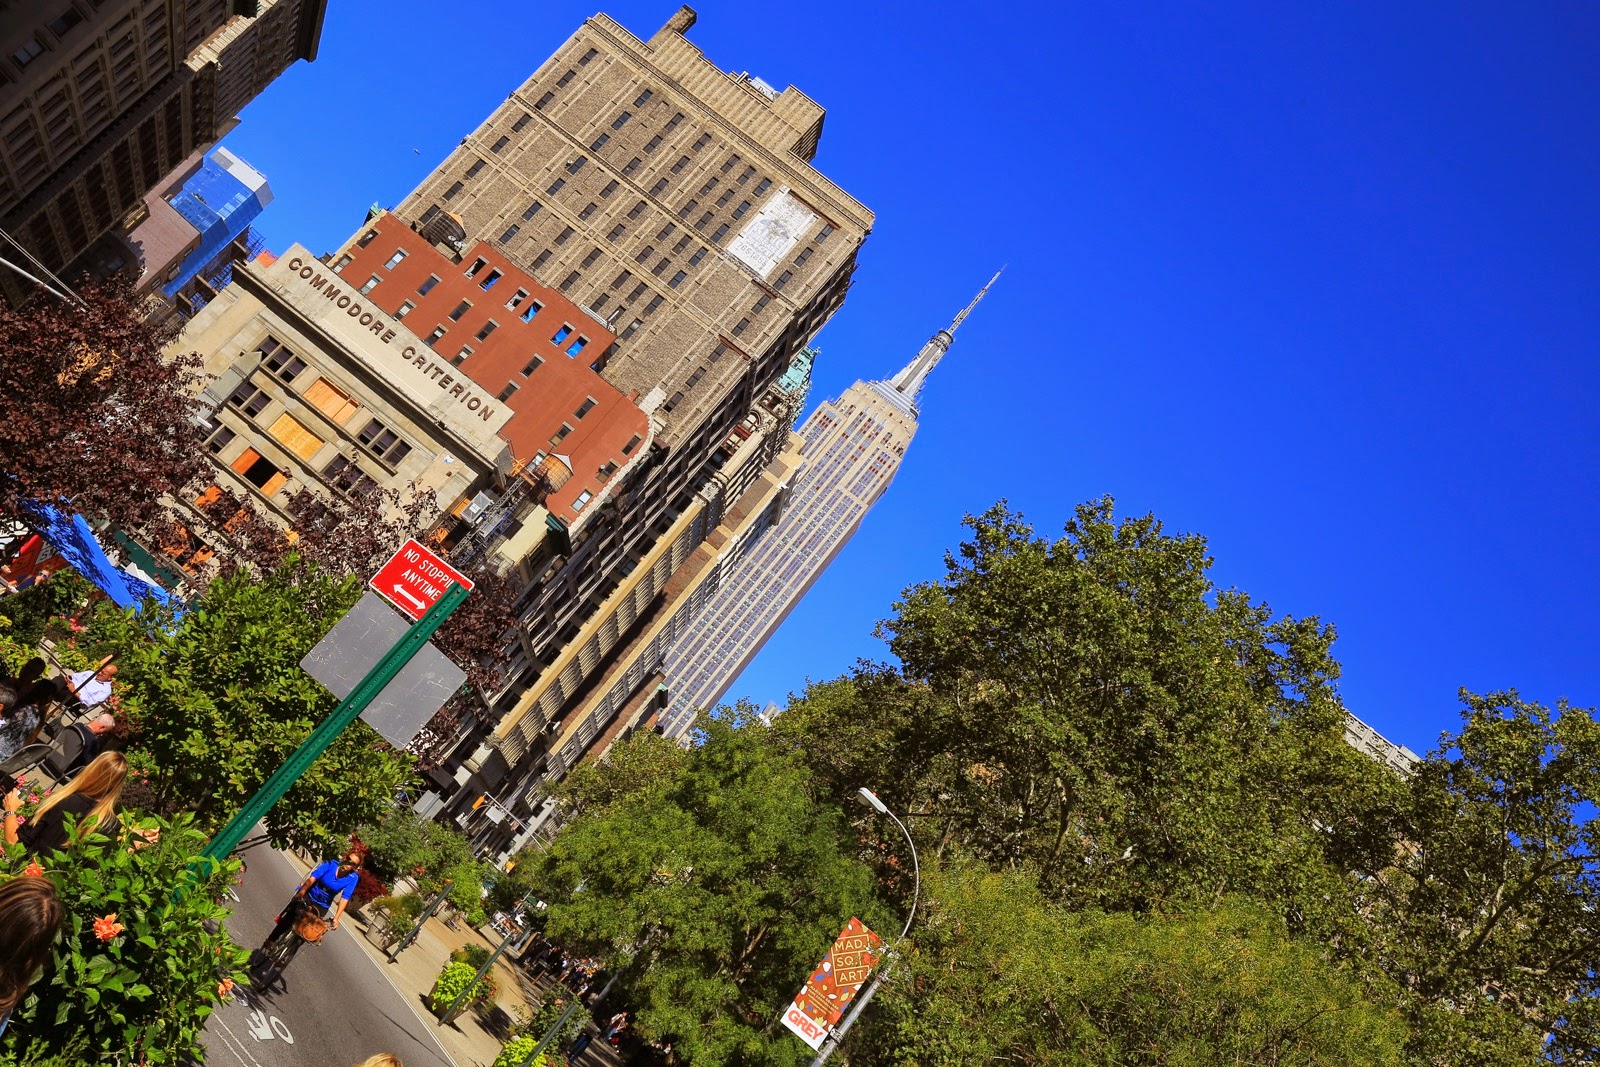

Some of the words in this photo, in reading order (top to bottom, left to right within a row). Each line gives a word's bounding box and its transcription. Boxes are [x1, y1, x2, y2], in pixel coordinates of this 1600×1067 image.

[289, 258, 397, 344] COMMODORE
[401, 346, 495, 422] CRITERION
[404, 548, 420, 564] NO
[401, 569, 441, 600] ANYTIME
[834, 939, 866, 951] MAD.
[788, 1009, 824, 1041] GREY
